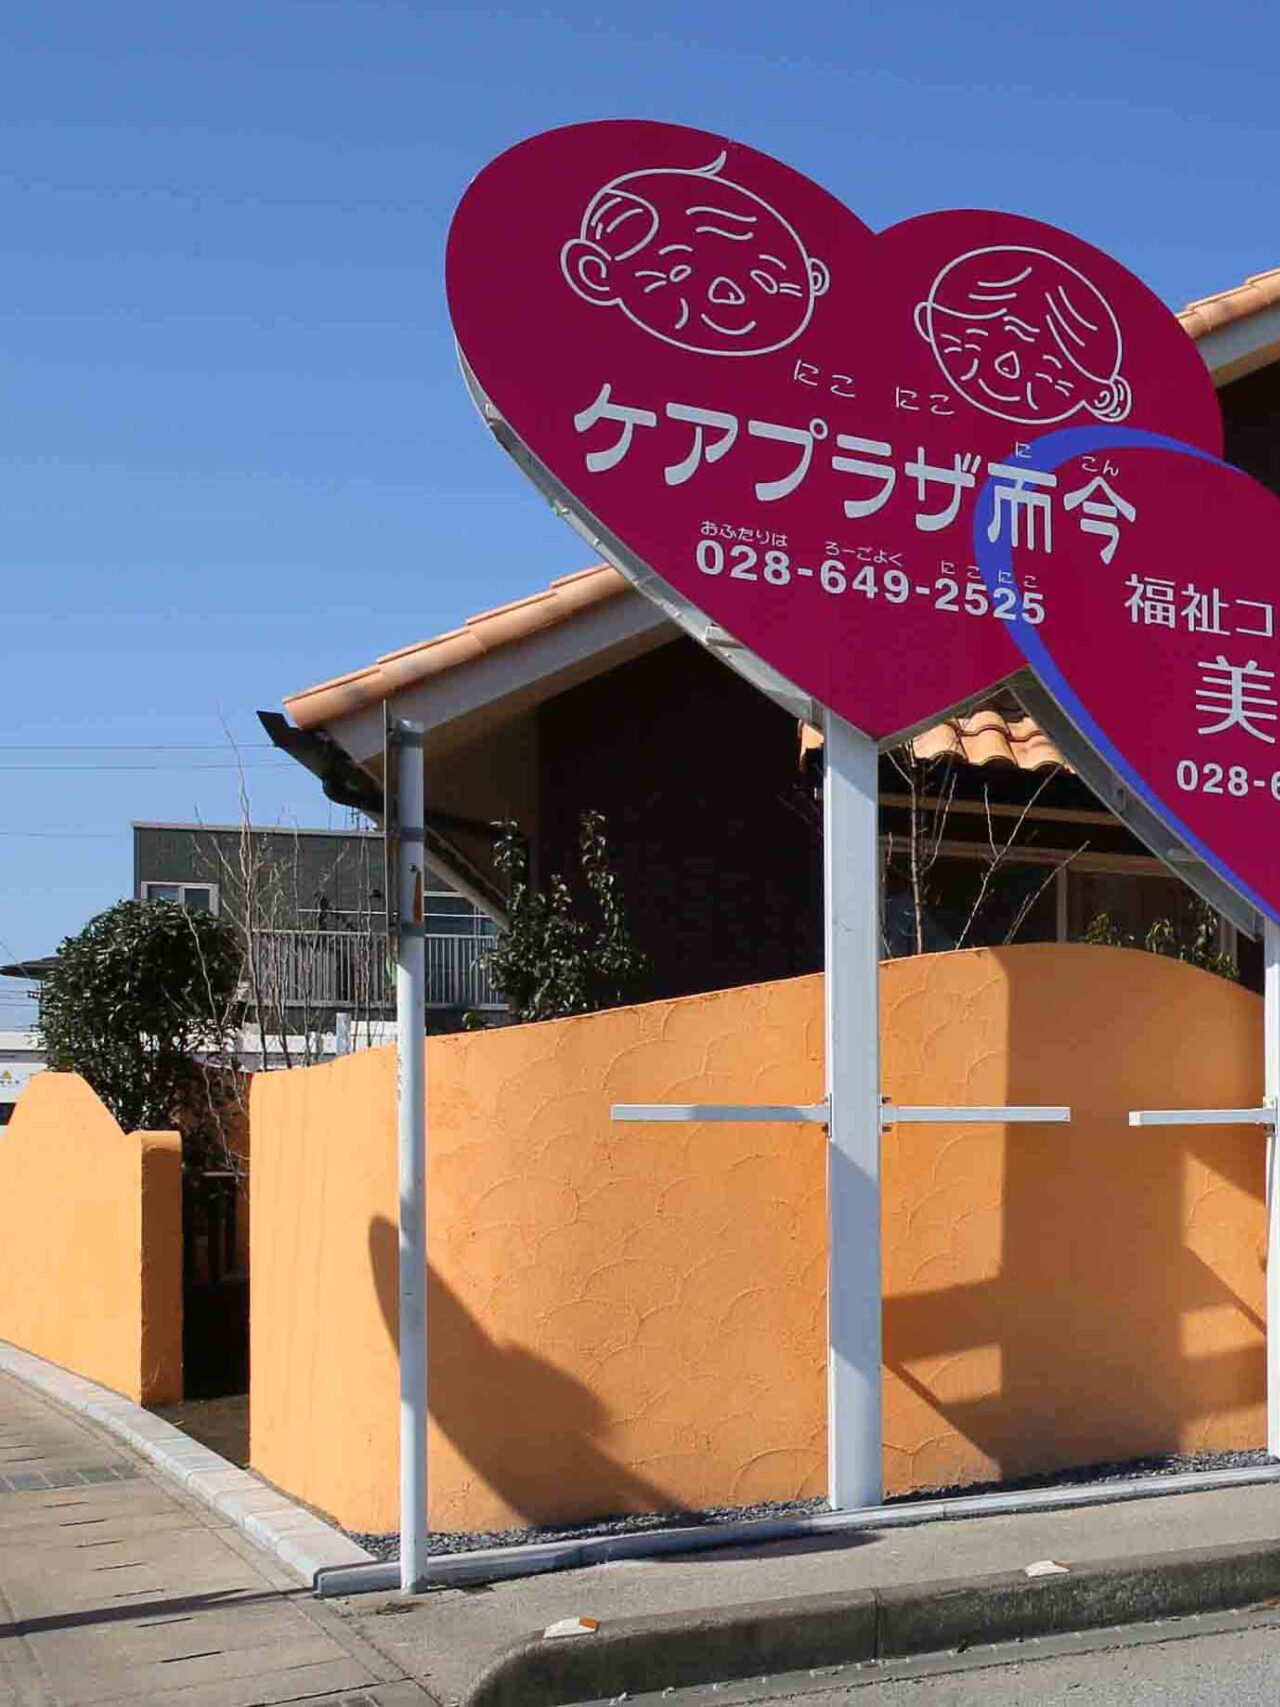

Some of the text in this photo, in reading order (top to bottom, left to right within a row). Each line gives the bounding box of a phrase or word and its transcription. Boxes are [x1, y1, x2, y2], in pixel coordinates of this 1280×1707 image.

[793, 359, 955, 415] にこ にこ
[1015, 441, 1119, 478] に こん
[700, 520, 789, 548] おふたりは
[696, 539, 1046, 625] 028-649-2525
